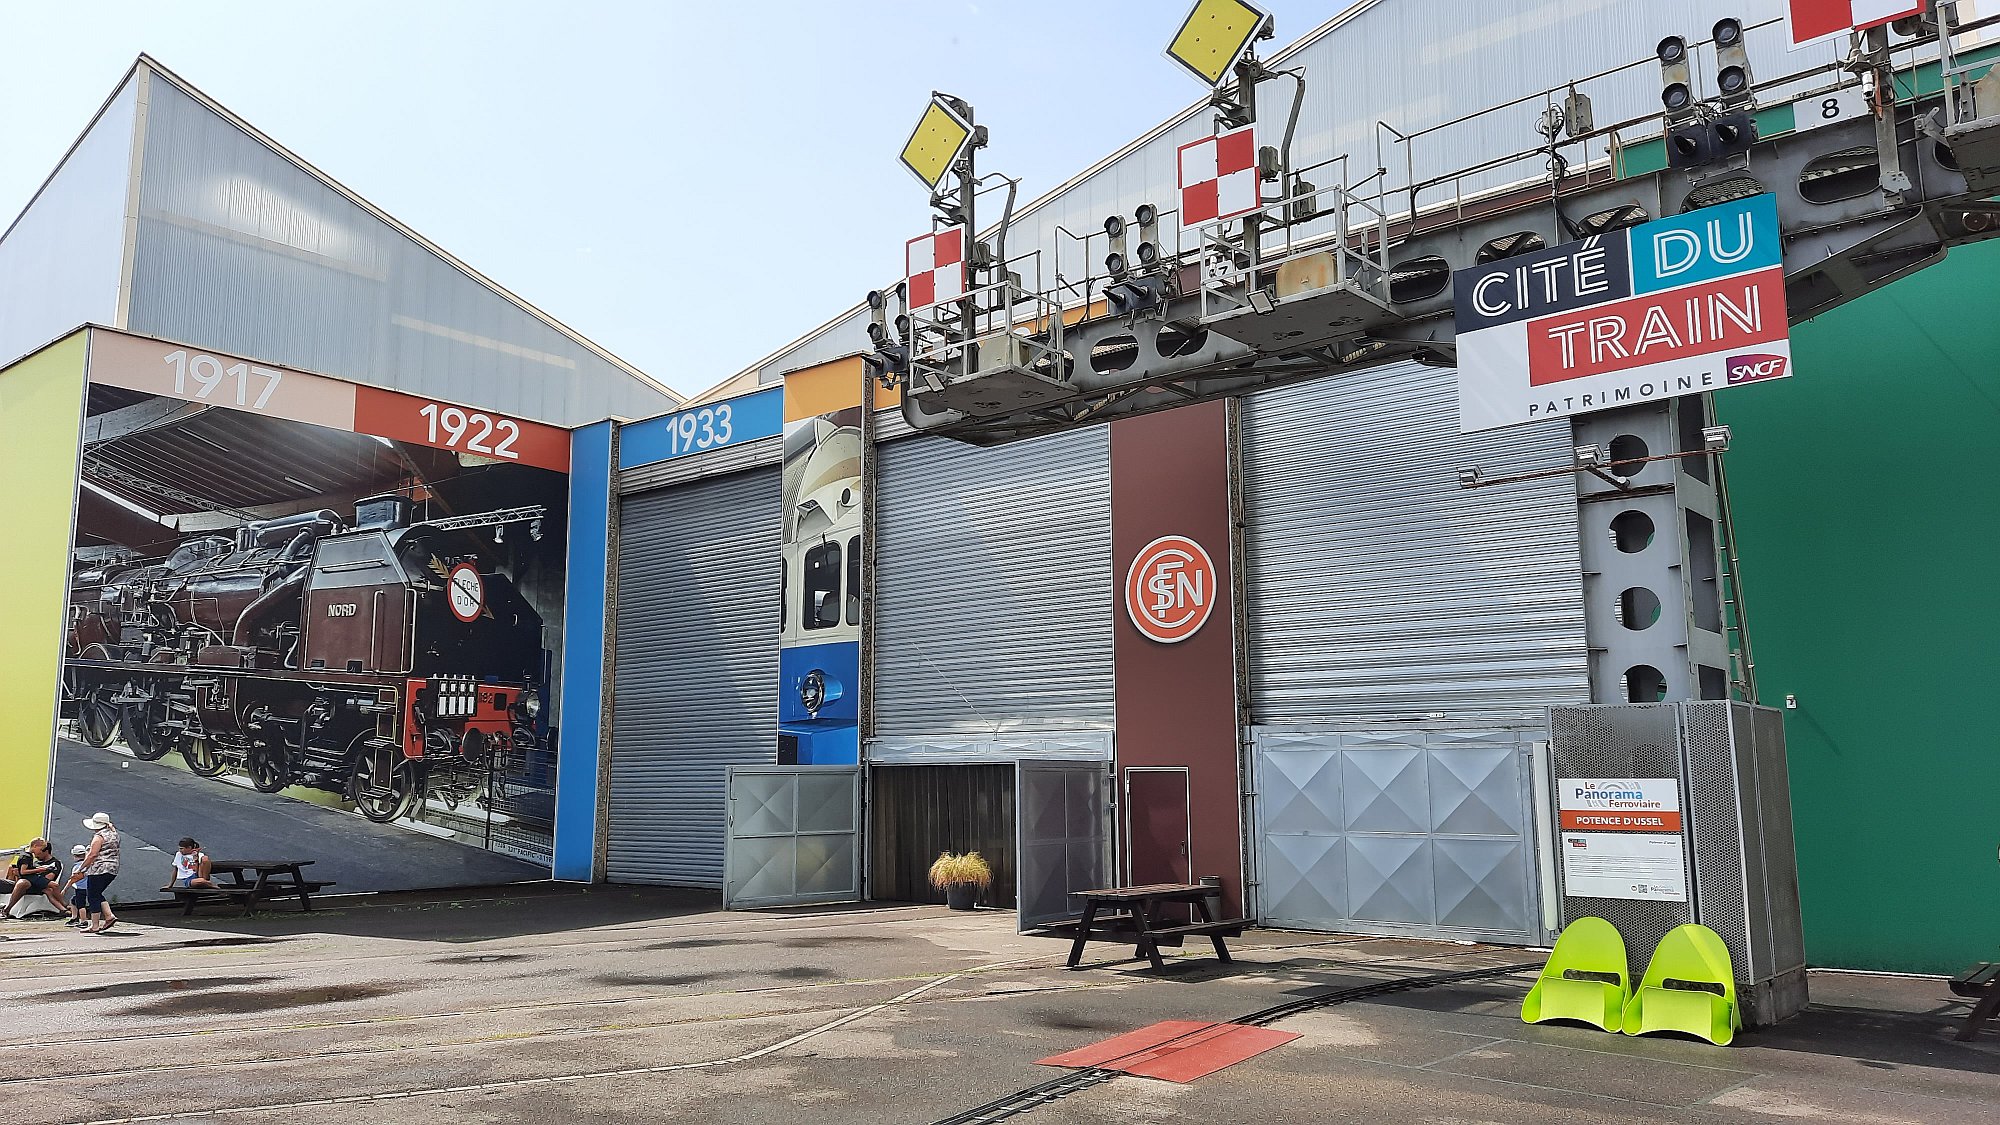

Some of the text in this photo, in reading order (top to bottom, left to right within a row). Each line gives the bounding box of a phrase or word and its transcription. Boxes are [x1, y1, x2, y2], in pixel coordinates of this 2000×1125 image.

[1822, 98, 1840, 119] 8
[1472, 211, 1755, 318] CITÉ DU
[1548, 285, 1762, 369] TRAIN
[163, 350, 282, 410] 1917
[1729, 358, 1783, 383] SNCF
[1529, 371, 1713, 417] PATRIMOINE
[419, 403, 520, 459] 1922
[666, 404, 733, 455] 1933
[327, 603, 357, 617] NORD
[1575, 788, 1643, 800] Panorama
[1608, 800, 1661, 809] Ferroviaire
[1576, 816, 1664, 826] POTENCE D'USSEL
